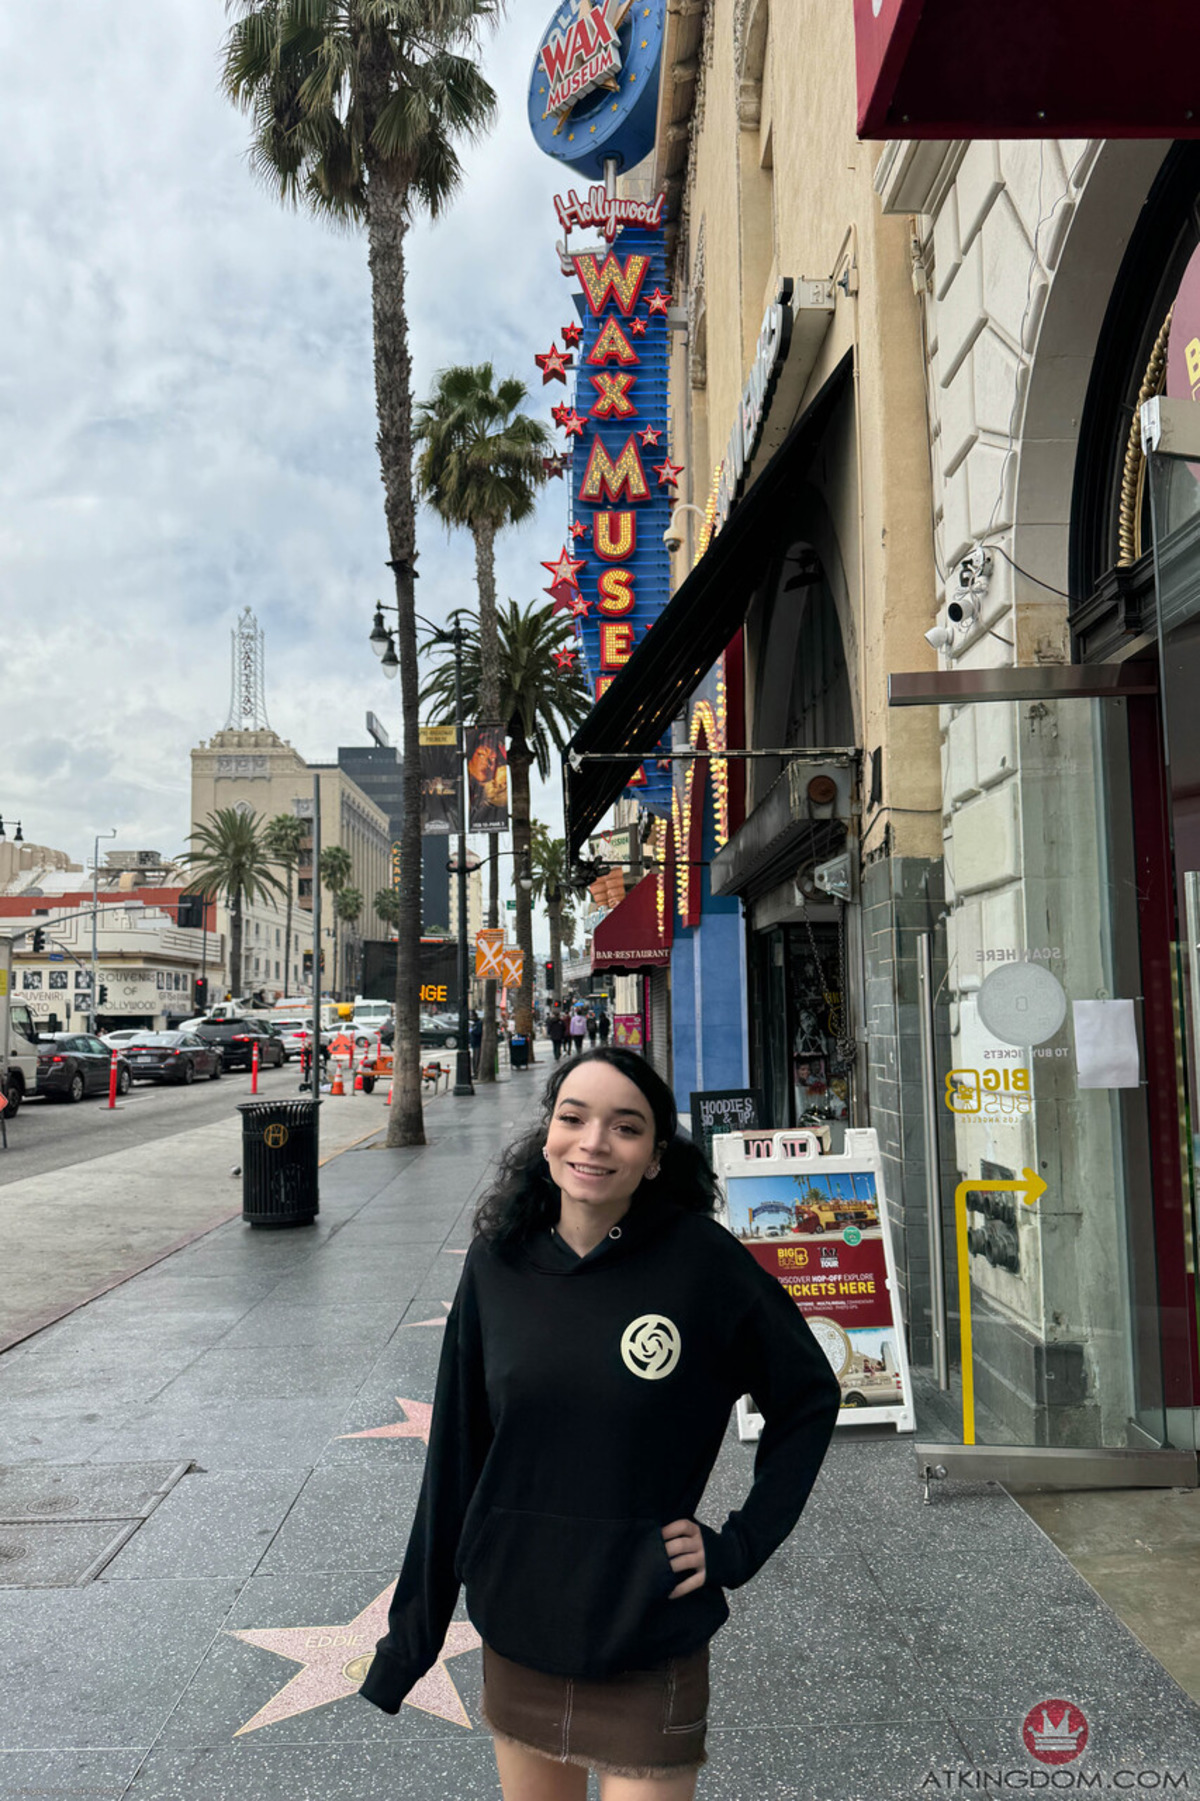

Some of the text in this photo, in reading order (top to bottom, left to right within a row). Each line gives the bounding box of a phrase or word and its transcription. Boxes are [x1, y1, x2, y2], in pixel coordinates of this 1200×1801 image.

[540, 0, 613, 86] WAX
[547, 45, 614, 112] MUSEUM
[553, 186, 665, 242] Hollywood
[571, 250, 651, 420] WAX
[596, 949, 669, 960] BAR-RESTAURANT
[123, 986, 138, 997] OF
[699, 1097, 753, 1115] HOODIES
[777, 1247, 795, 1258] BIG
[820, 1259, 839, 1268] TOUR
[812, 1274, 842, 1283] HOP-OFF
[844, 1273, 874, 1282] EXPLORE
[839, 1281, 876, 1295] HERE
[305, 1635, 365, 1648] EDDIE
